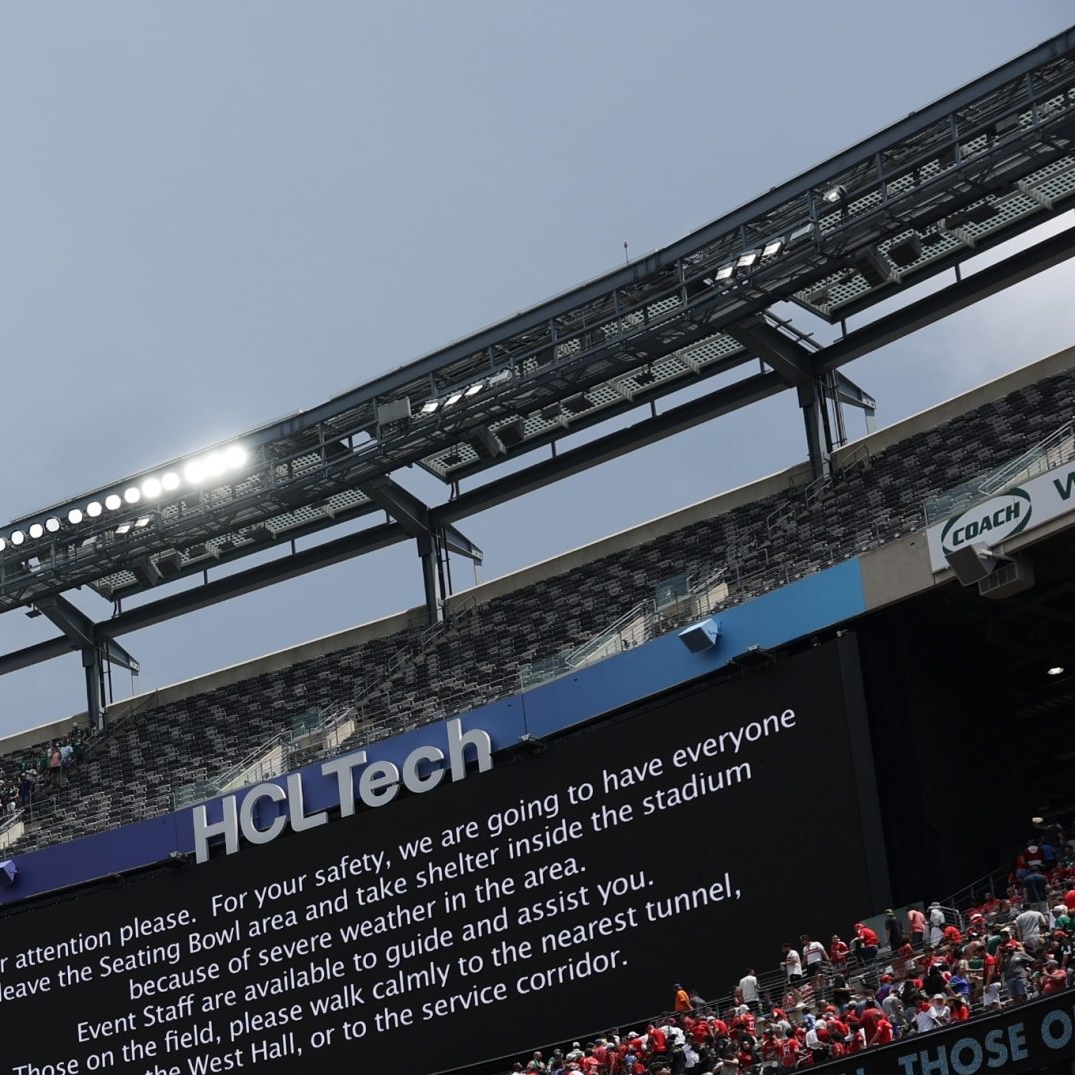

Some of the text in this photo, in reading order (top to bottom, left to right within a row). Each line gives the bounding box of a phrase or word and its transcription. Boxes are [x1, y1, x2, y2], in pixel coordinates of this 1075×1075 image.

[951, 500, 1021, 547] COACH
[15, 930, 112, 969] attention
[119, 909, 197, 947] please.
[211, 891, 248, 917] For
[253, 874, 307, 909] your
[315, 850, 391, 887] safety,
[398, 836, 433, 861] we
[441, 821, 479, 848] are
[487, 793, 559, 838] going
[567, 782, 594, 805] to
[602, 758, 664, 794] have
[672, 708, 796, 768] everyone
[192, 717, 494, 865] HCLTech
[57, 964, 93, 988] the
[99, 942, 181, 978] Seating
[188, 919, 241, 954] Bowl
[248, 910, 299, 938] area
[305, 888, 349, 921] and
[355, 876, 408, 906] take
[416, 847, 500, 889] shelter
[508, 818, 584, 860] inside
[590, 804, 634, 832] the
[642, 762, 752, 816] stadium
[129, 857, 586, 1001] because of severe weather in the area.
[77, 870, 654, 1043] Event Staff are available to guide and assist you.
[86, 1050, 114, 1071] on
[121, 1039, 158, 1063] the
[164, 1020, 221, 1053] field,
[229, 1004, 303, 1043] please
[309, 983, 366, 1017] walk
[372, 961, 451, 1000] calmly
[457, 955, 484, 977] to
[490, 940, 533, 967] the
[541, 907, 639, 954] nearest
[644, 872, 741, 922] tunnel,
[251, 1031, 303, 1064] Hall,
[310, 1027, 336, 1049] or
[342, 1020, 367, 1041] to
[374, 1007, 414, 1032] the
[422, 982, 508, 1021] service
[516, 949, 628, 995] corridor.
[1040, 1008, 1075, 1049] O
